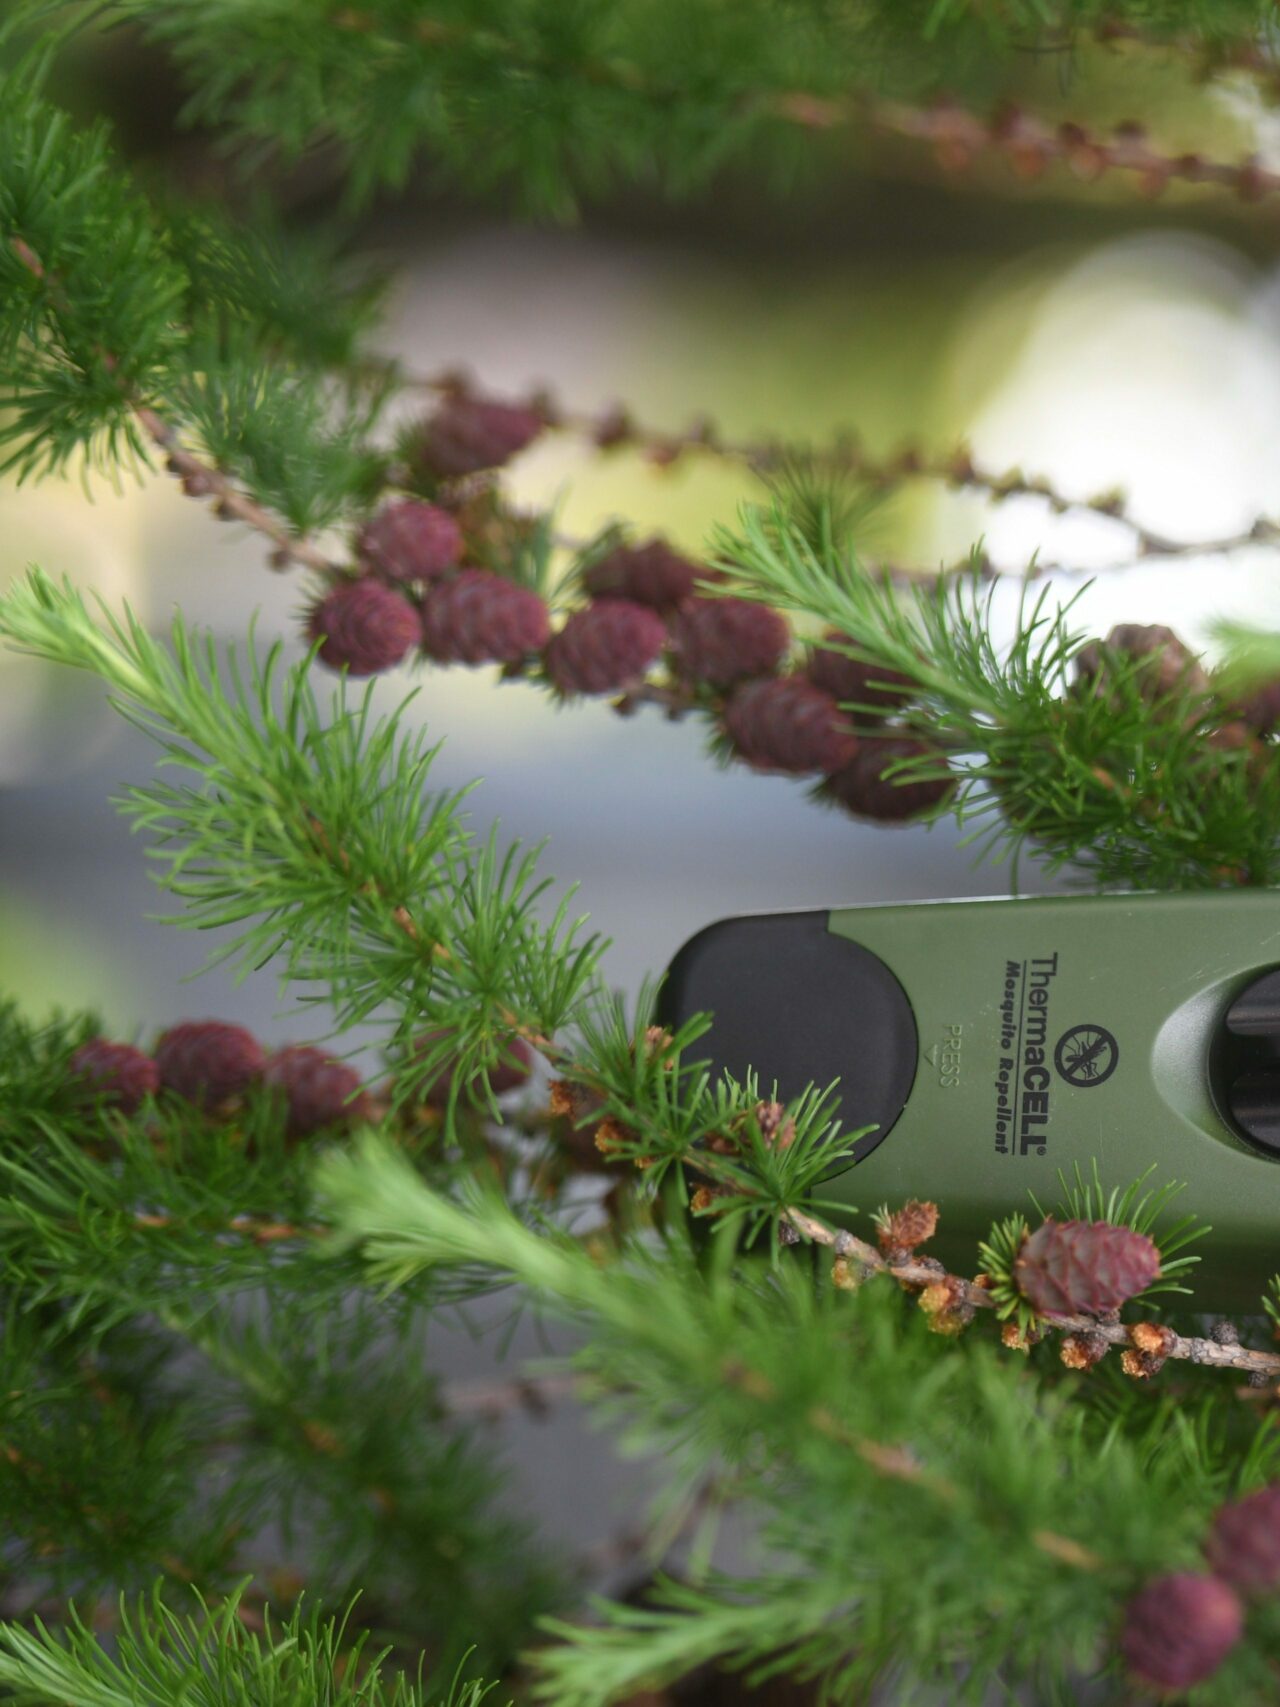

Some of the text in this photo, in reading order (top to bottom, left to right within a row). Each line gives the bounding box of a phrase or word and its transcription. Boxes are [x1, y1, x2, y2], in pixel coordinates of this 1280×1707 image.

[941, 1024, 962, 1088] PRESS
[995, 960, 1020, 1155] Mosquito Repellent
